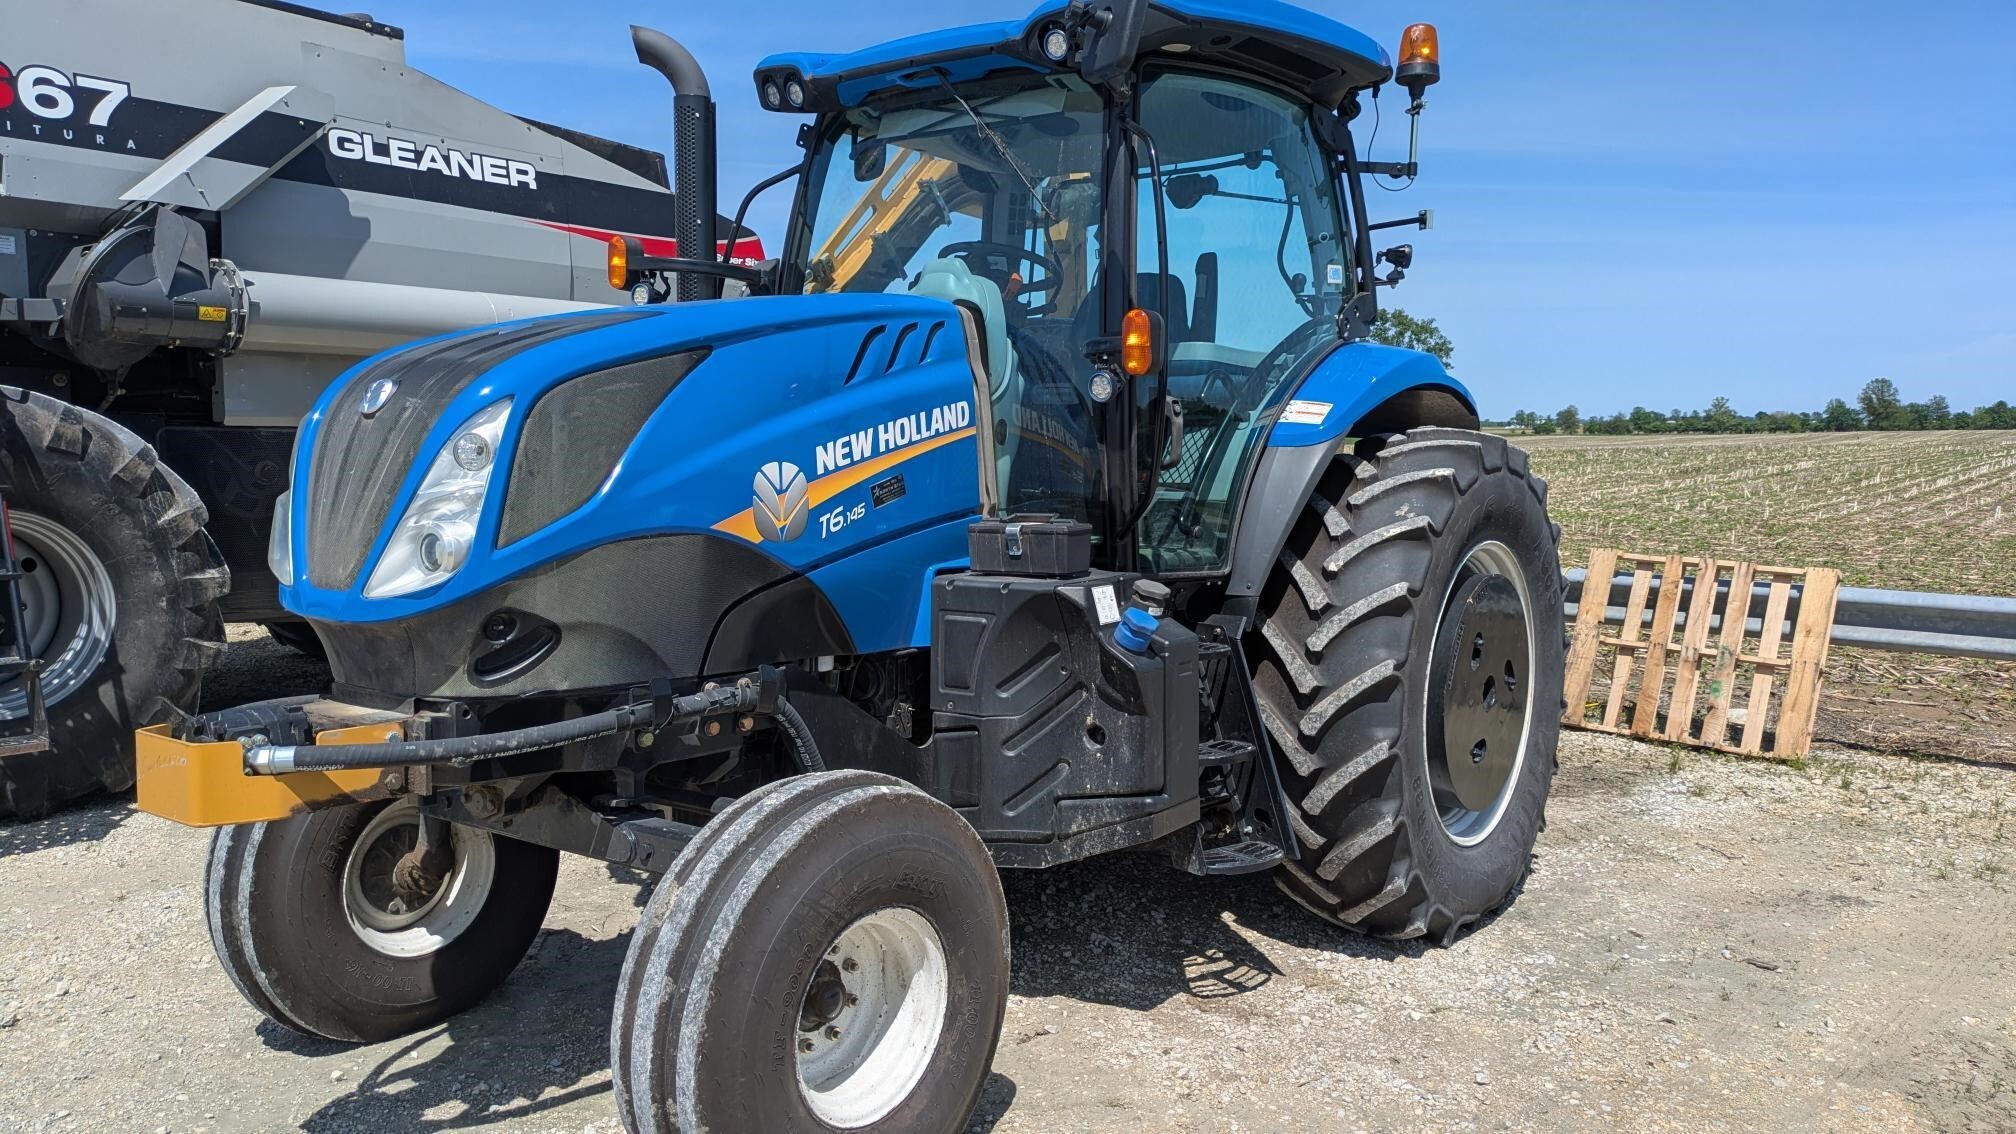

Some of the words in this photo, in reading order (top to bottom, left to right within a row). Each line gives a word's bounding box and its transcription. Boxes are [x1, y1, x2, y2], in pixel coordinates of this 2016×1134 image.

[0, 60, 132, 127] 67
[327, 127, 538, 191] GLEANER
[716, 253, 743, 266] Ser
[815, 427, 874, 476] NEW
[877, 400, 970, 452] HOLLAND
[819, 502, 866, 539] T6.145
